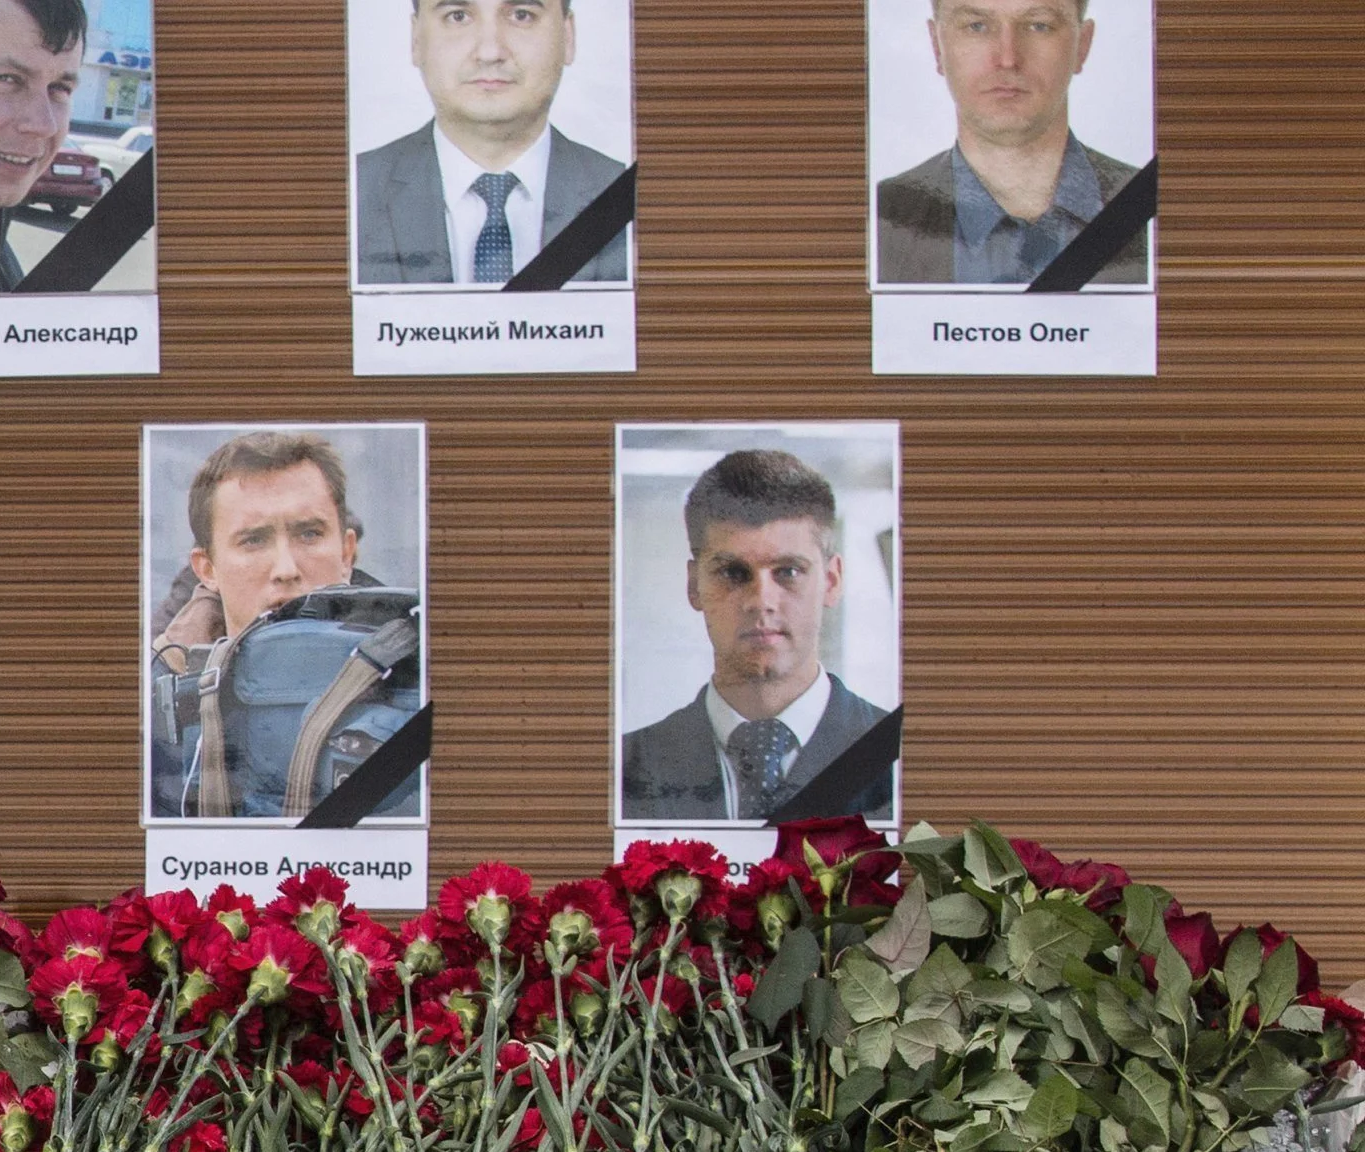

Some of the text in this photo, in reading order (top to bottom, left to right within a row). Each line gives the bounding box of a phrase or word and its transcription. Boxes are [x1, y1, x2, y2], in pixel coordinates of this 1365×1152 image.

[3, 324, 138, 348] Александр
[377, 320, 604, 347] Лужецкий Михаил
[933, 322, 1090, 343] Пестов Олег
[161, 856, 269, 880] Суранов
